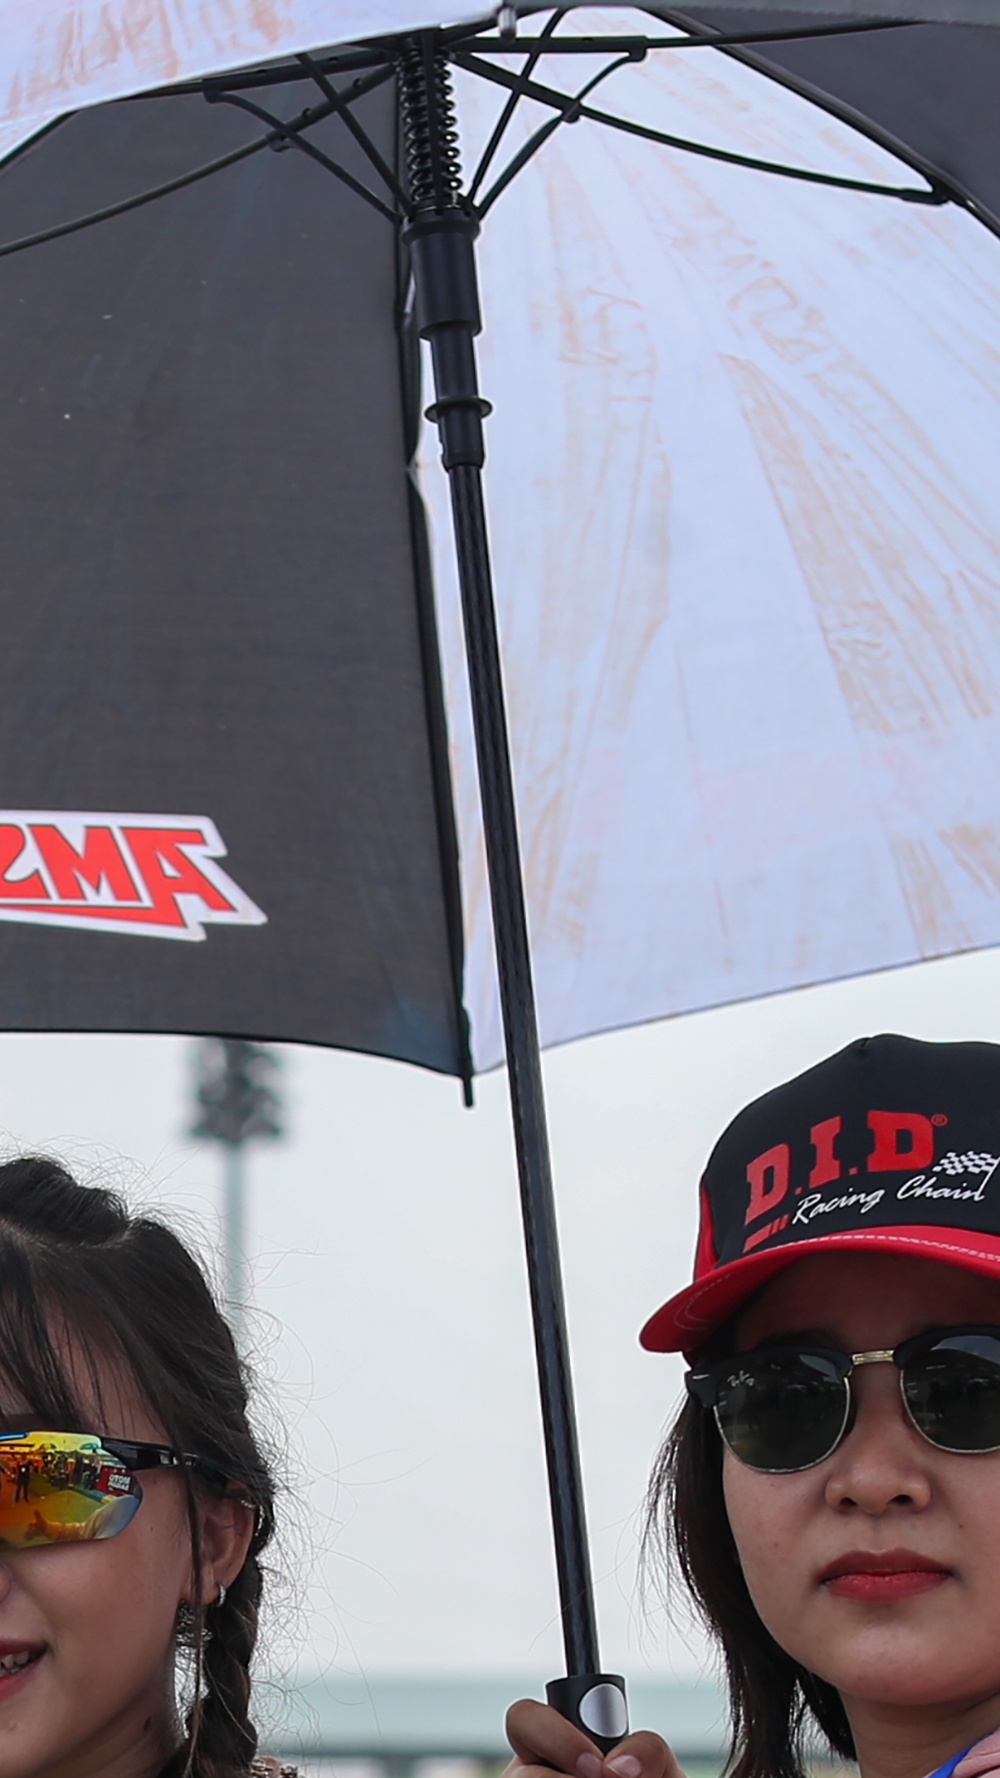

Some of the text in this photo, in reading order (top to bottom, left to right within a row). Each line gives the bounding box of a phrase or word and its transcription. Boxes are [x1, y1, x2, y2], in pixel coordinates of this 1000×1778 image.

[744, 1109, 935, 1227] D.I.D
[791, 1173, 985, 1225] Racing Chain
